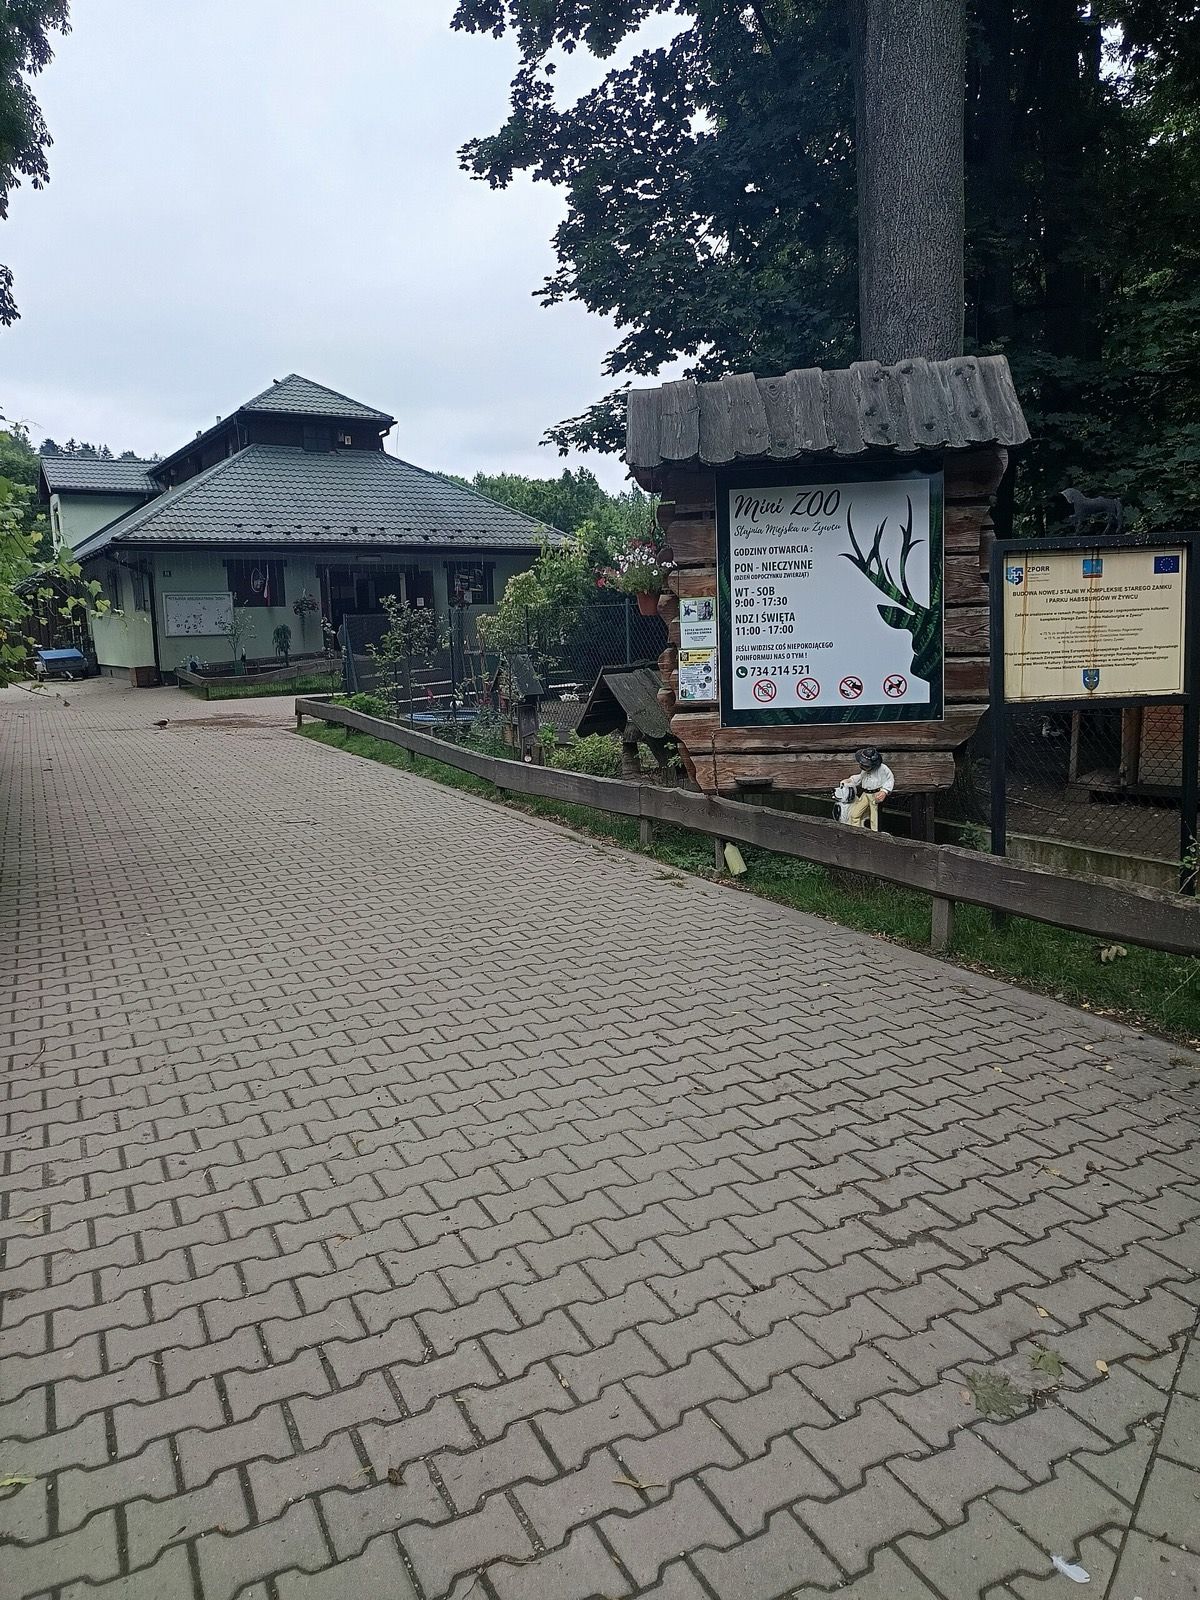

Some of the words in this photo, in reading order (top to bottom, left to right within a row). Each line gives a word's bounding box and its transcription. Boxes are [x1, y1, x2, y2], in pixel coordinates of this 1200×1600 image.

[734, 494, 784, 523] Mini
[790, 489, 841, 517] ZOO
[734, 525, 764, 539] Stajnia
[765, 522, 799, 537] Miejska
[734, 547, 767, 556] GODZINY
[768, 545, 808, 555] OTWARCIA
[735, 563, 754, 572] PON
[762, 560, 812, 571] NIECZYNNE
[735, 588, 750, 597] WT
[757, 586, 775, 596] SOB
[735, 598, 754, 608] 9:00
[762, 596, 788, 606] 17:30
[736, 614, 754, 624] NDZ
[756, 614, 759, 623] I
[762, 612, 796, 624] ŚWIĘTA
[736, 626, 760, 636] 11:00
[768, 625, 794, 634] 17:00
[776, 643, 786, 651] COŚ
[787, 642, 834, 650] NIEPOKOJĄCEGO
[750, 667, 769, 676] 734
[771, 666, 790, 676] 214
[792, 665, 810, 675] 521
